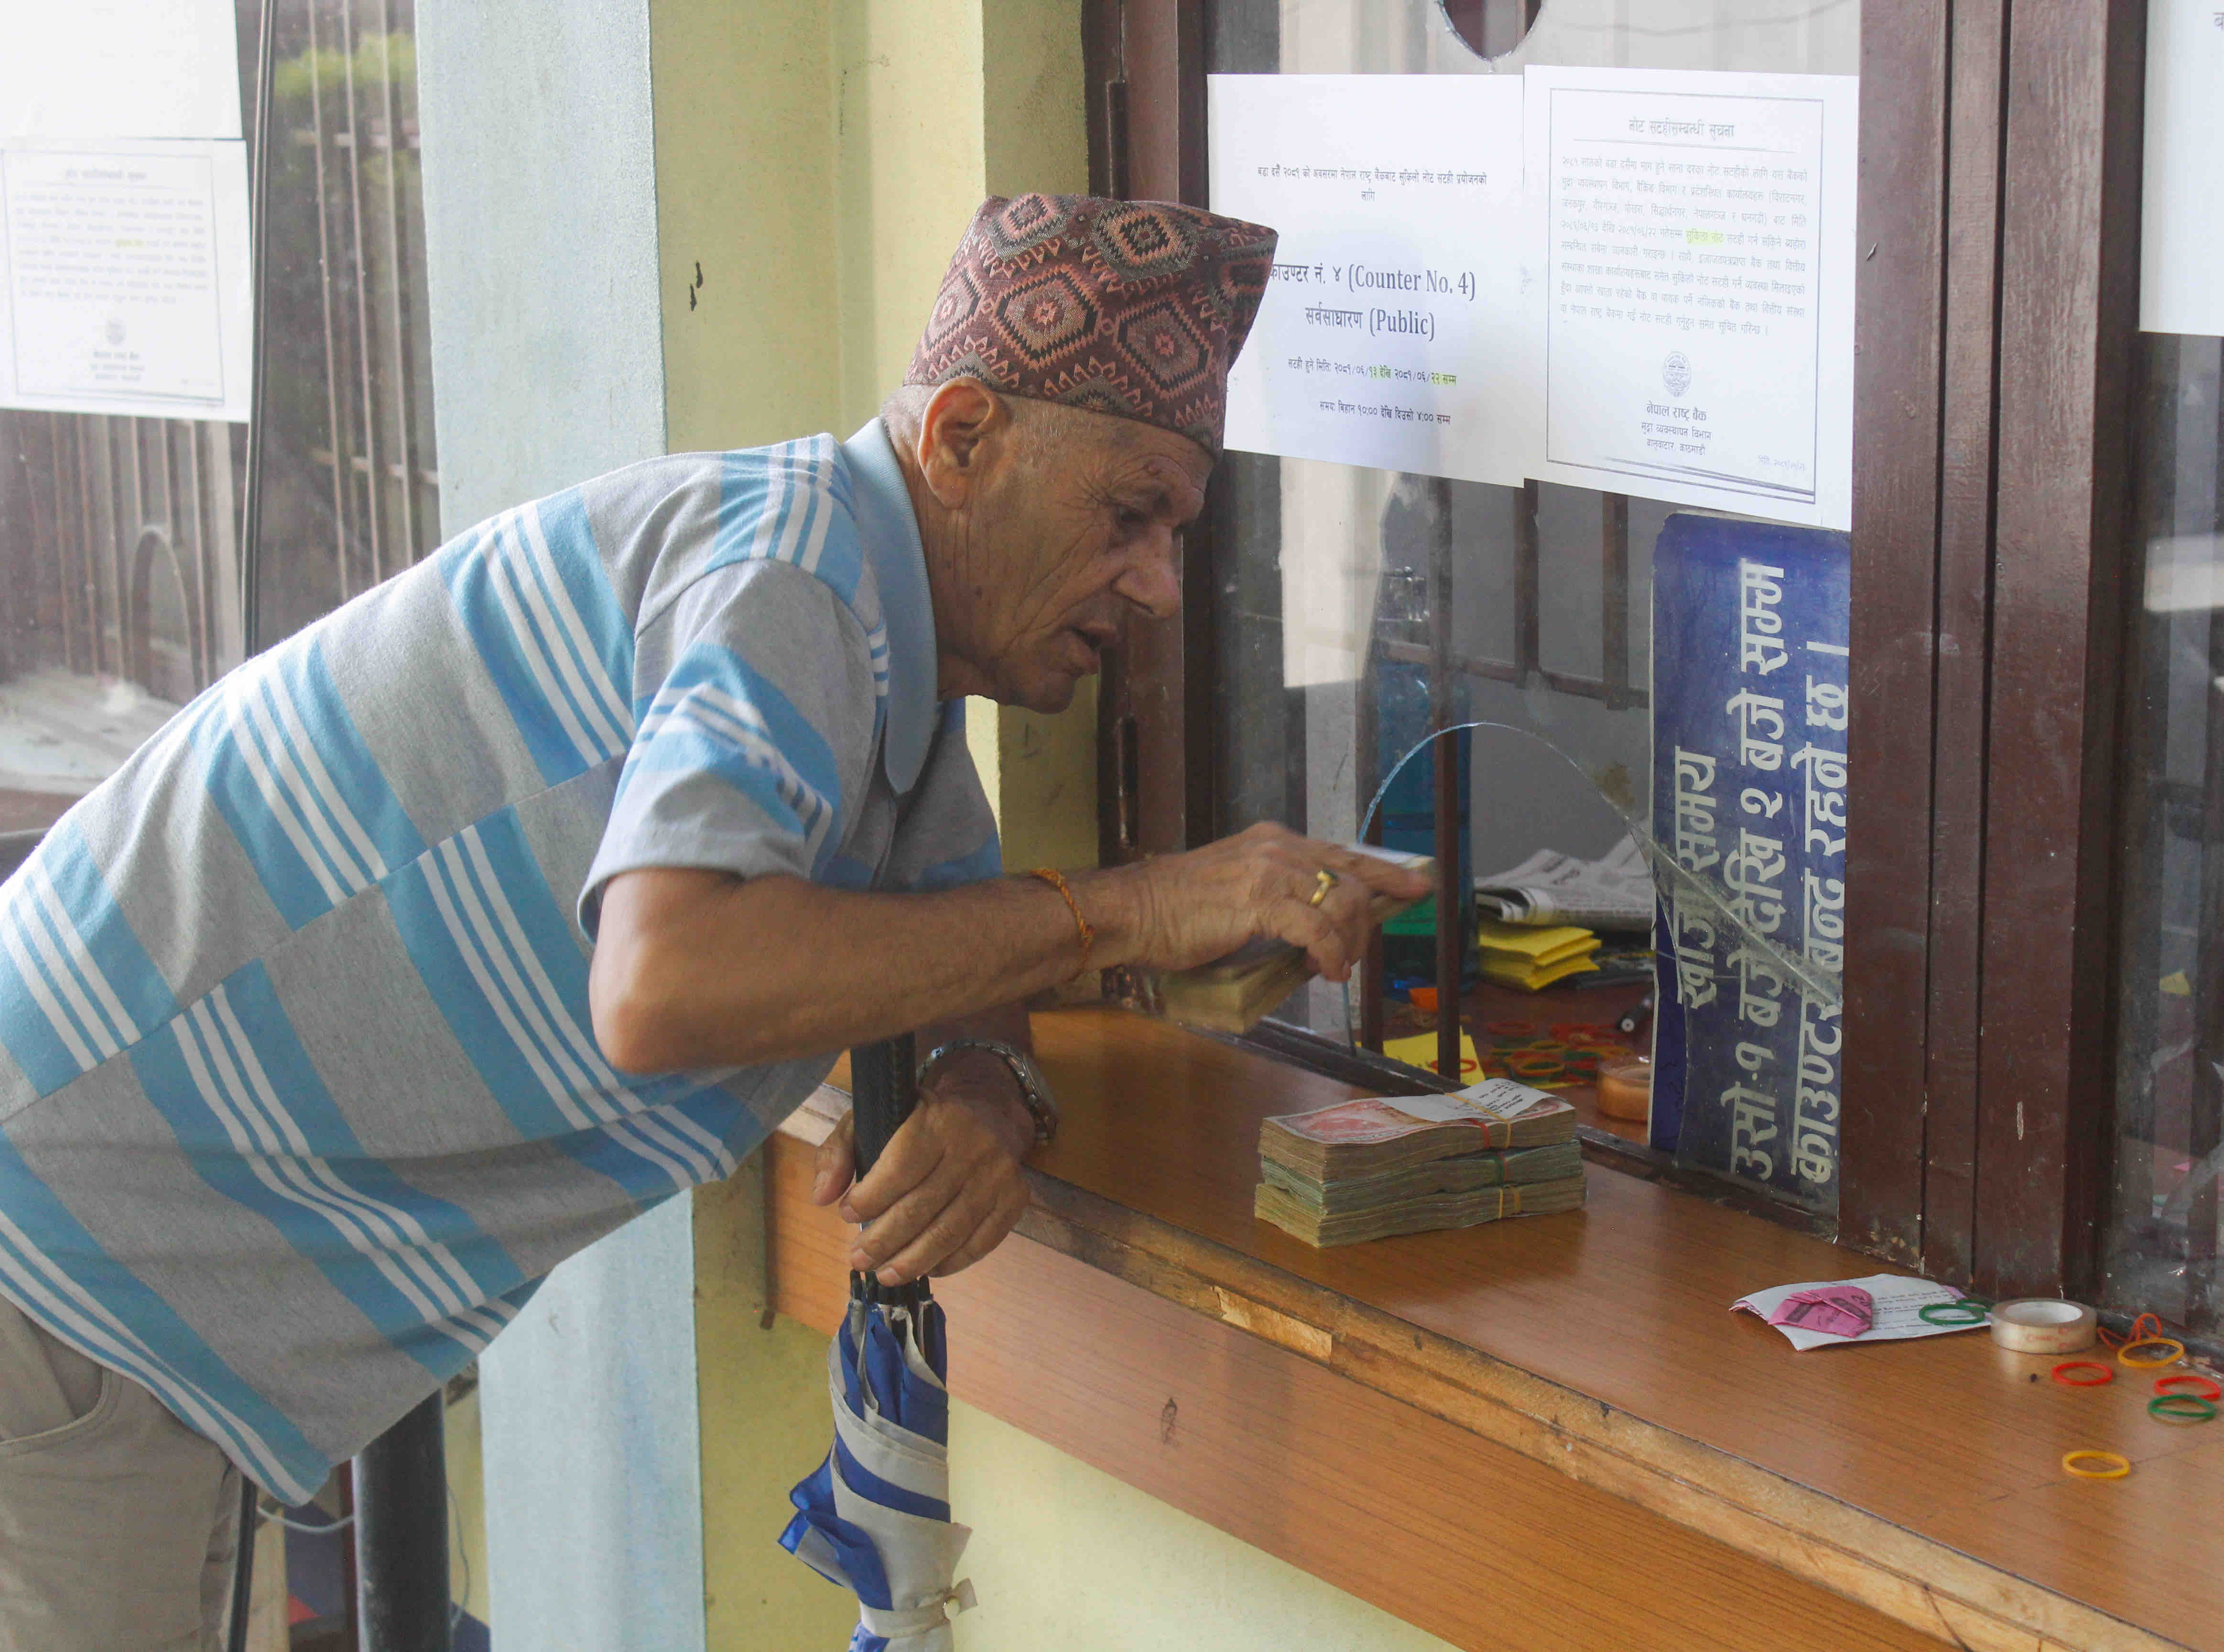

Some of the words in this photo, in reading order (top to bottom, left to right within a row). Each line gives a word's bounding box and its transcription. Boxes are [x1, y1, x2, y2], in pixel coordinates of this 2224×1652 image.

[1628, 116, 1646, 134] नोट
[1283, 166, 1300, 179] २०८१
[1302, 165, 1311, 178] को
[1313, 169, 1338, 180] अवसरमा
[1340, 166, 1356, 180] नेपाल
[1359, 170, 1372, 184] राष्ट्र
[1422, 169, 1434, 184] नोट
[1437, 170, 1454, 184] सटही
[1360, 187, 1376, 201] लागि
[1314, 262, 1326, 285] नं.
[1333, 266, 1342, 283] ४
[1348, 263, 1421, 293] (Counter
[1426, 269, 1453, 293] No.
[1457, 271, 1475, 302] 4)
[1304, 301, 1363, 329] सर्वसाधारण
[1369, 307, 1435, 342] (Public)
[1288, 356, 1303, 370] सटही
[1305, 356, 1314, 373] हुने
[1334, 361, 1377, 379] २०८१/०६/१३
[1379, 364, 1391, 379] देखि
[1395, 368, 1440, 385] २०८१/०६/२२
[1442, 374, 1457, 385] सम्म
[1338, 399, 1356, 414] बिहान
[1358, 404, 1378, 417] १०:००
[1380, 405, 1392, 419] देखि
[1395, 406, 1414, 421] दिउसो
[1417, 411, 1433, 424] ४:००
[1437, 414, 1451, 425] सम्म
[1646, 400, 1670, 417] नेपाल
[1673, 405, 1690, 423] राष्ट्र
[1692, 425, 1712, 440] विभाग
[1740, 557, 1788, 676] सम्म
[1806, 675, 1849, 731] छ
[1726, 687, 1784, 771] बजे
[1675, 745, 1720, 871] समय
[1740, 787, 1783, 819] २
[1790, 741, 1848, 857] रहने
[1724, 827, 1786, 934] देखि
[1803, 867, 1845, 972] बन्द
[1726, 942, 1783, 1027] बजे
